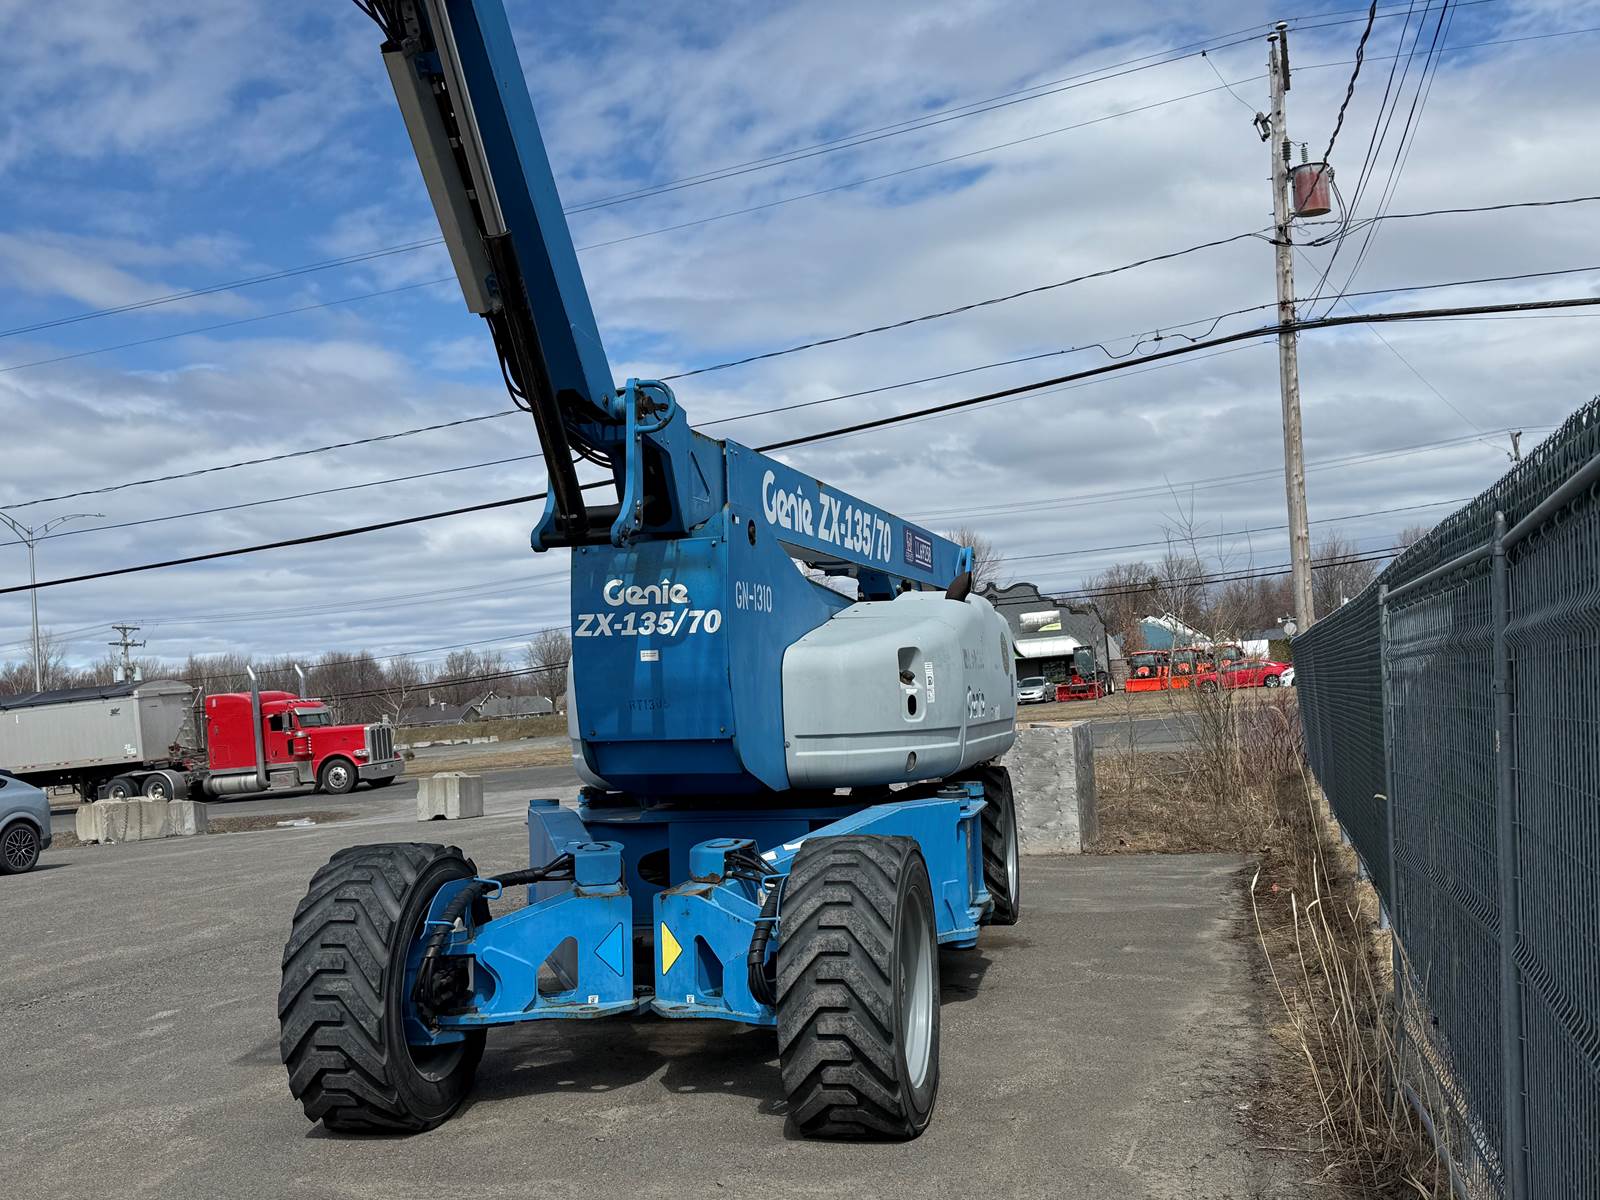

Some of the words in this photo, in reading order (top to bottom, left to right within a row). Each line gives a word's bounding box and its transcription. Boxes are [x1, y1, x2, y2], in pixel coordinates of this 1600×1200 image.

[762, 470, 814, 537] Genie
[818, 492, 892, 563] ZX-135/70
[603, 578, 689, 606] Genie
[735, 581, 773, 613] GN-1310
[574, 608, 722, 637] ZX-135/70
